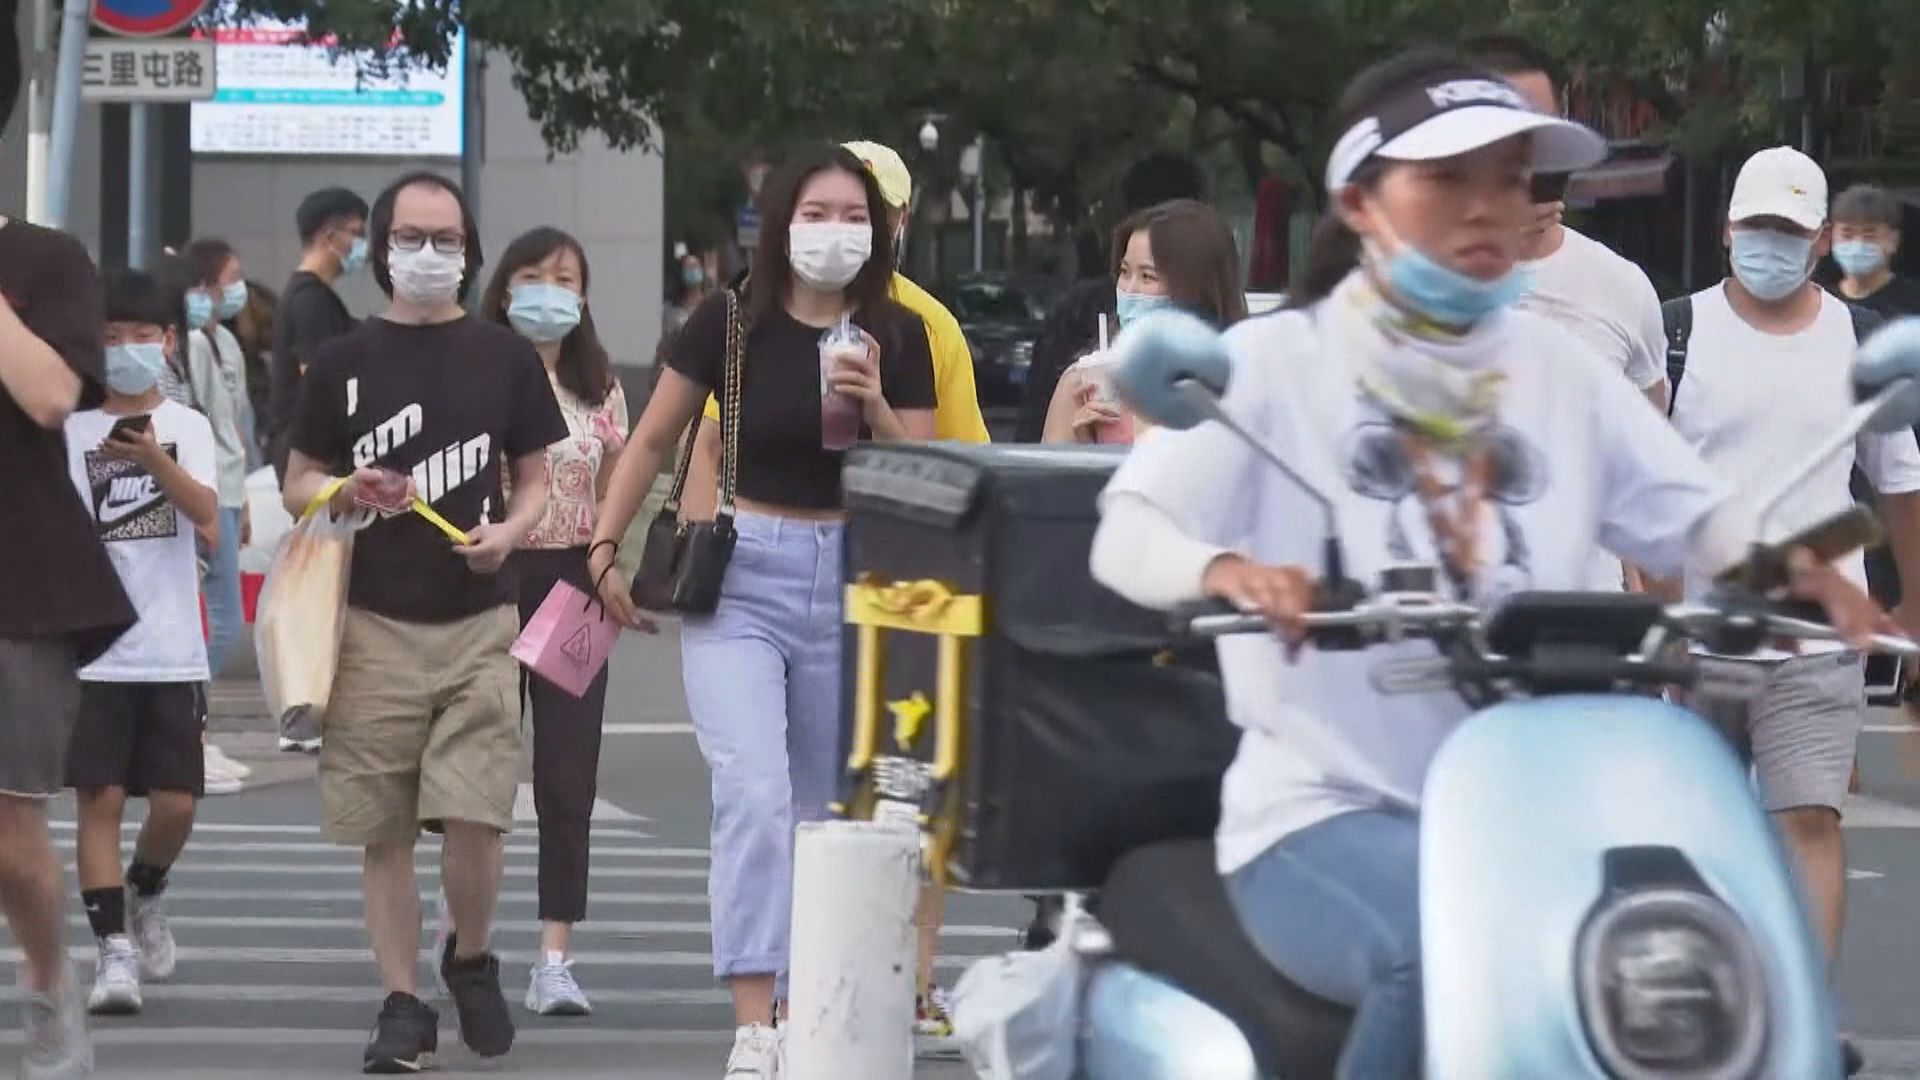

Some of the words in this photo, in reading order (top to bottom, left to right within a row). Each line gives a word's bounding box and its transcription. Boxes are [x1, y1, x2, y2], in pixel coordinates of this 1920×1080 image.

[82, 50, 203, 88] 三里屯路
[352, 402, 423, 469] am
[109, 475, 157, 502] NIKE
[411, 432, 491, 506] llin
